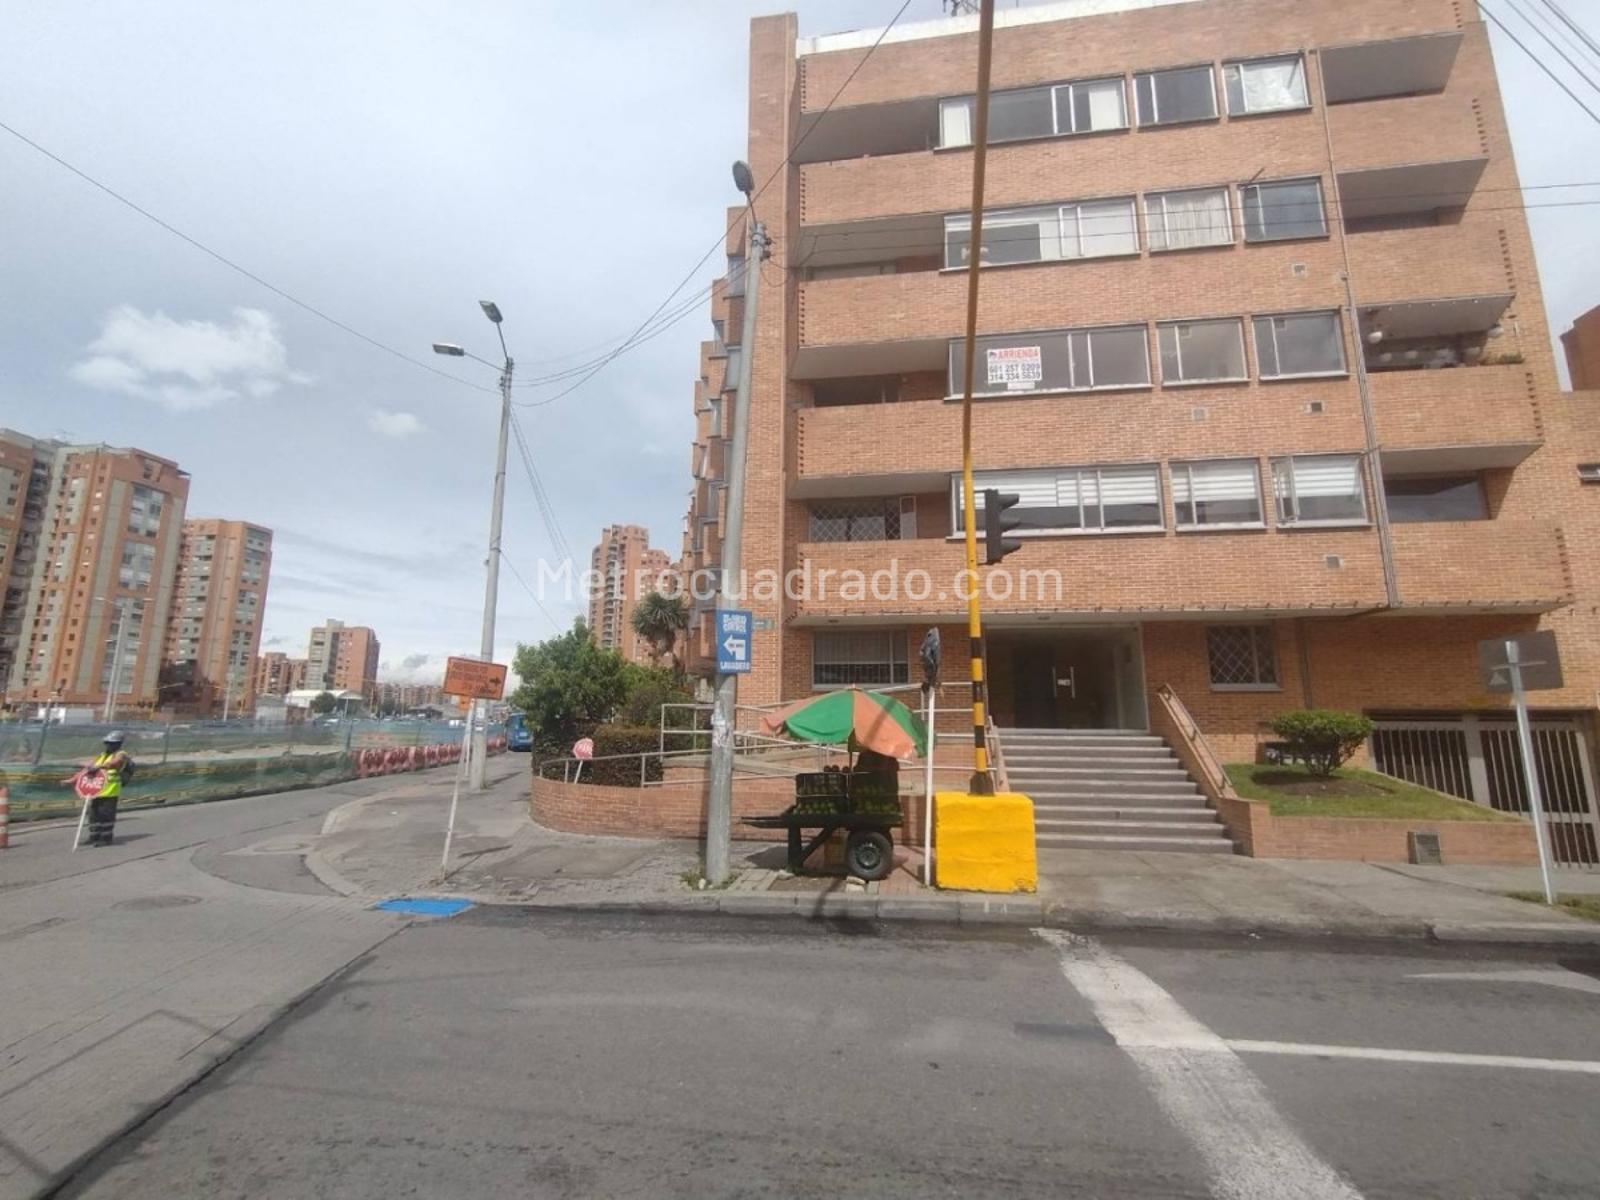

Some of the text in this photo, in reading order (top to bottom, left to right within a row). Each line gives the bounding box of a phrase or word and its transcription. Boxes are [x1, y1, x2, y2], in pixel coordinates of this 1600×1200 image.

[998, 348, 1039, 360] ARRIENDA
[989, 373, 1003, 382] 314
[81, 775, 103, 790] PARE
